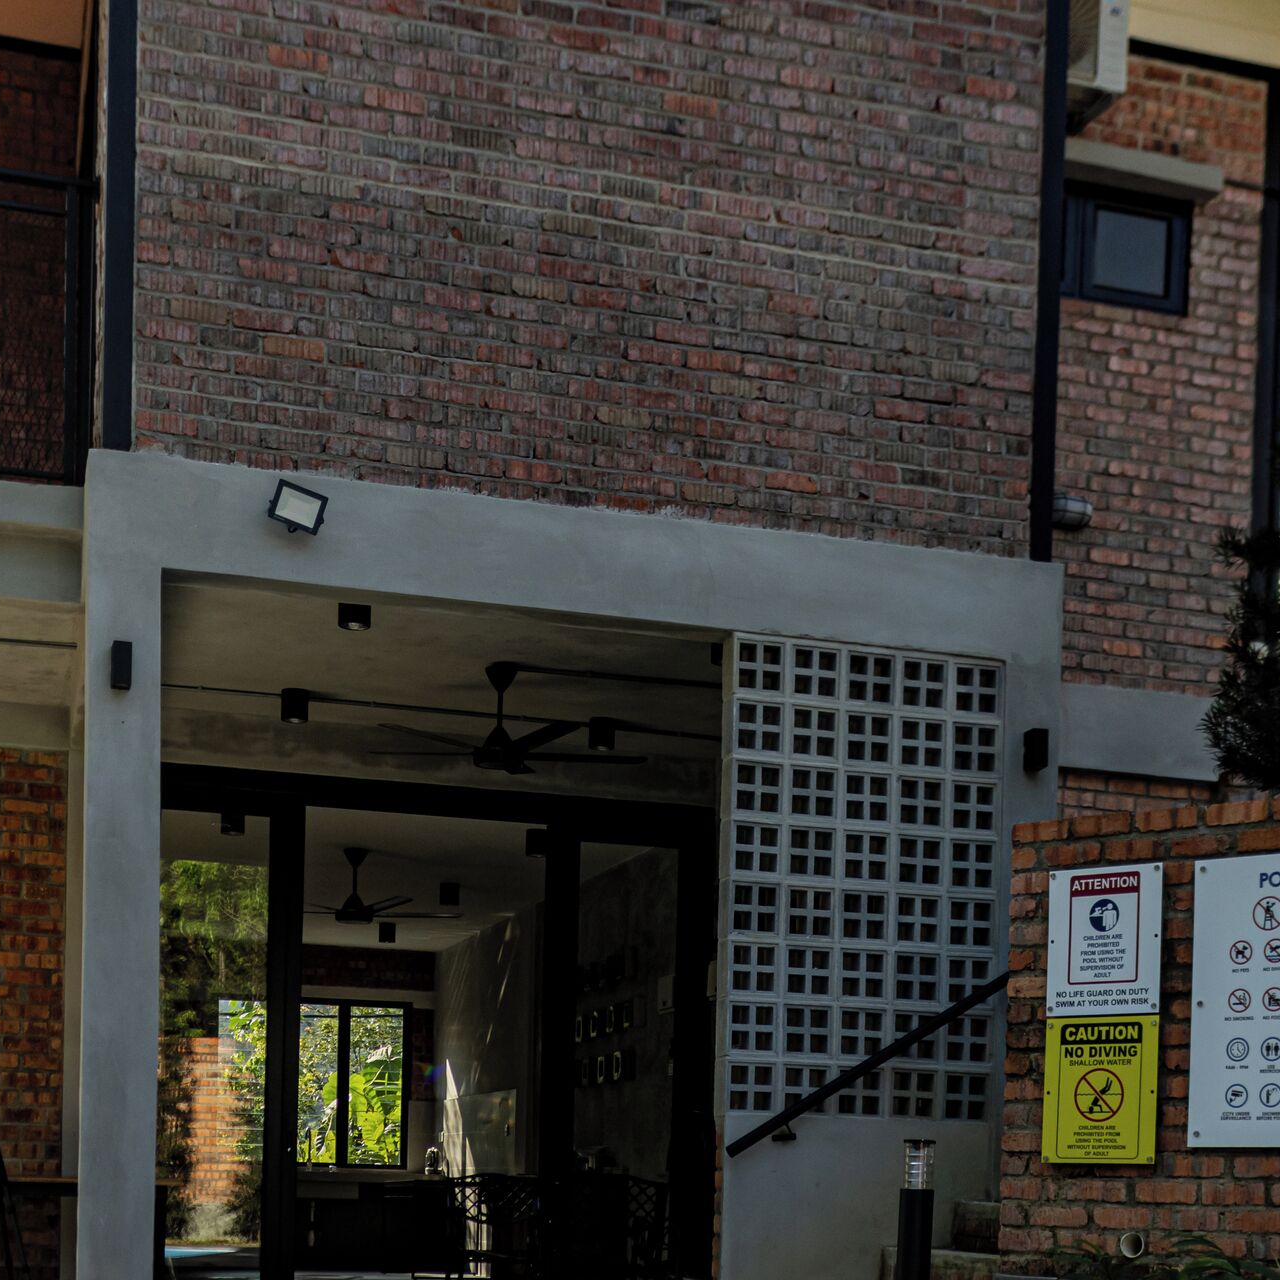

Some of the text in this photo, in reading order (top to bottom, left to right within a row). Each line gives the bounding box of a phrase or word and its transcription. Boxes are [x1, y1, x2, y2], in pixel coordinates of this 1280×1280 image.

[1072, 876, 1137, 891] ATTENTION
[1087, 989, 1113, 997] GUARD
[1111, 998, 1129, 1006] OWN
[1065, 1025, 1138, 1041] CAUTION
[1064, 1045, 1138, 1058] NO DIVING
